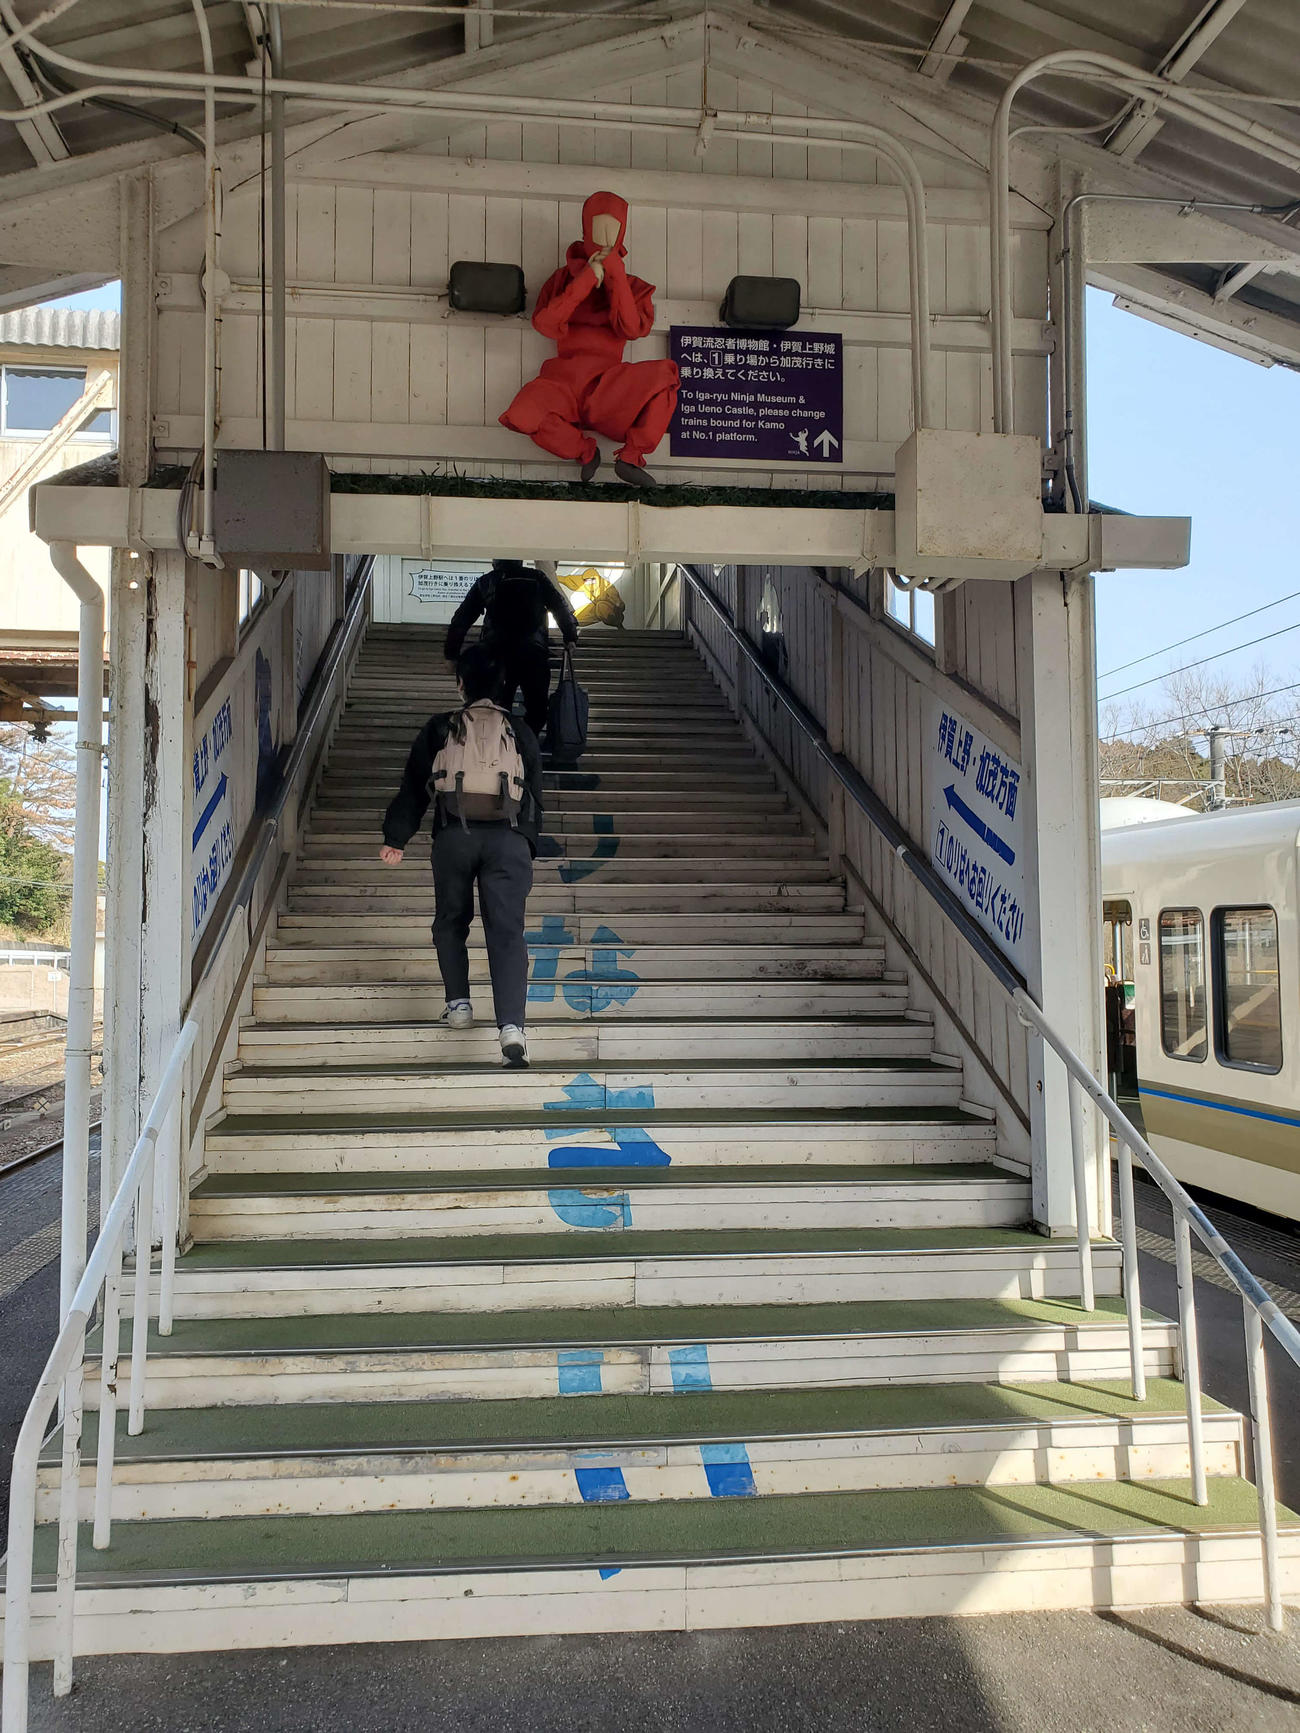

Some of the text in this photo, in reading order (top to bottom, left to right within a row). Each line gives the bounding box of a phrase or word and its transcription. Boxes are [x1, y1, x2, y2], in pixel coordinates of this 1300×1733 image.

[681, 335, 835, 355] 伊賀流忍者博物館・伊賀上野城
[680, 367, 786, 383] 乗り換えてください。
[681, 390, 806, 404] To Iga-ryu Ninja Museum &
[681, 403, 826, 420] Iga Ueno Castle, please change
[681, 417, 785, 430] trains bound for Kamo
[681, 431, 758, 442] at No.1 platform.
[193, 695, 233, 800] 賀上野・加茂方面
[938, 711, 1021, 822] 伊賀上野・加茂方面
